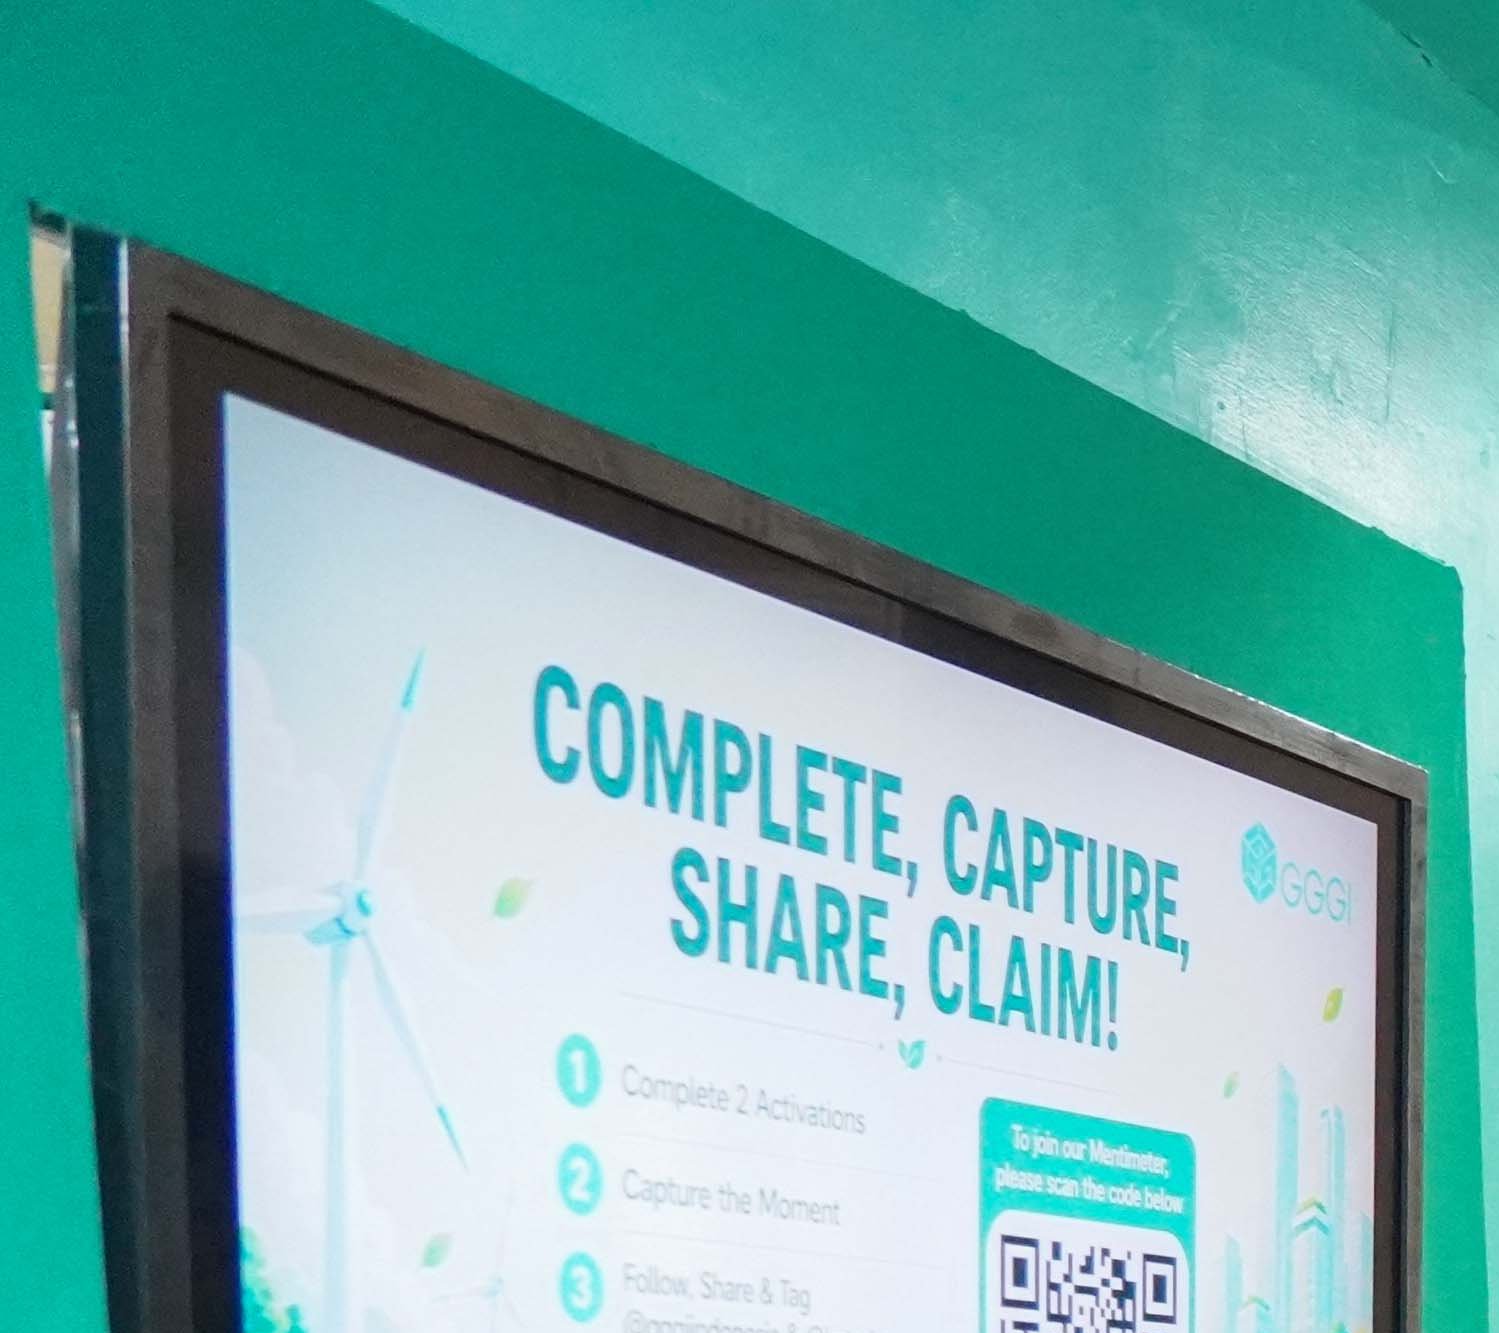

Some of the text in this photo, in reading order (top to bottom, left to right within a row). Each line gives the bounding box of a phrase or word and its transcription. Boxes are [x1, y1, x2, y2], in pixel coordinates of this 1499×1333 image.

[533, 664, 1190, 973] COMPLETE, CAPTURE,
[1281, 861, 1351, 926] GGGI
[670, 846, 1119, 1051] SHARE, CLAIM!
[621, 1064, 866, 1135] Complete 2 Activations
[1011, 1124, 1030, 1151] To
[1032, 1129, 1059, 1159] join
[1062, 1138, 1088, 1161] our
[567, 1156, 593, 1202] 2
[621, 1168, 841, 1227] Capture the Moment
[995, 1163, 1185, 1216] please scan the code below
[569, 1265, 593, 1310] 3
[623, 1263, 812, 1316] Follow, Share & Tag
